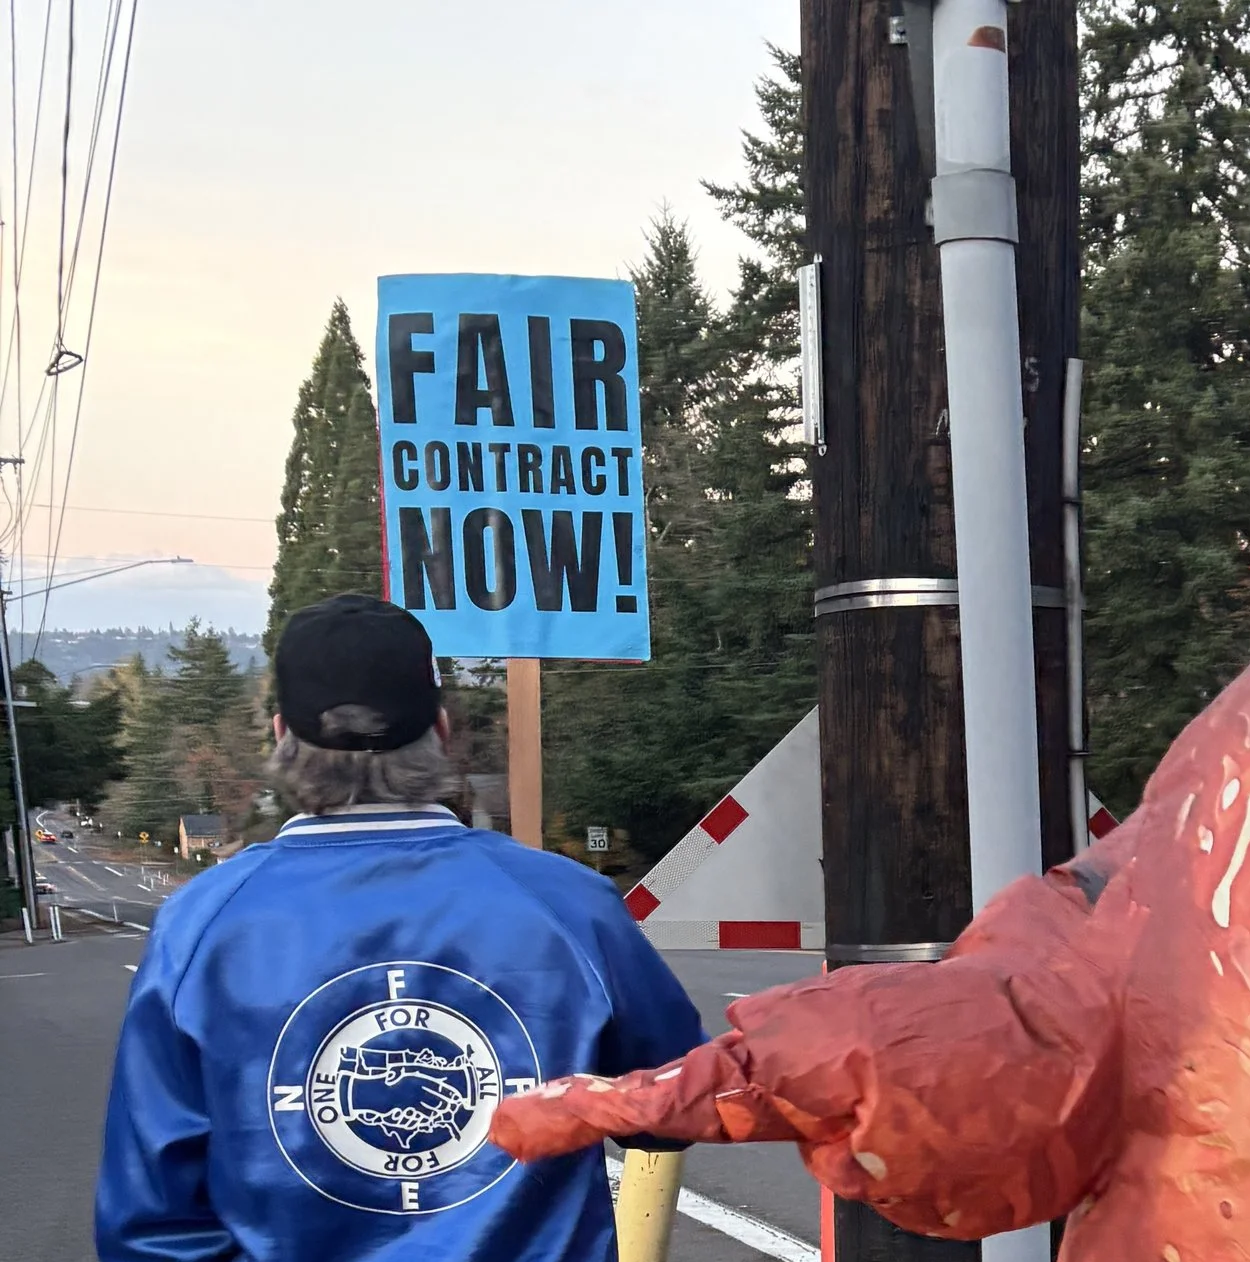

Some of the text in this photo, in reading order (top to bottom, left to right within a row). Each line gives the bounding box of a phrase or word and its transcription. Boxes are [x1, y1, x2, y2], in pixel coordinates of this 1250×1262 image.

[388, 312, 629, 431] FAIR
[392, 440, 633, 496] CONTRACT
[398, 507, 638, 613] NOW!
[590, 839, 606, 849] 30
[387, 969, 406, 1000] F
[273, 1085, 305, 1112] N
[313, 1008, 498, 1172] ONE FOR ALL FOR
[401, 1181, 420, 1211] E
